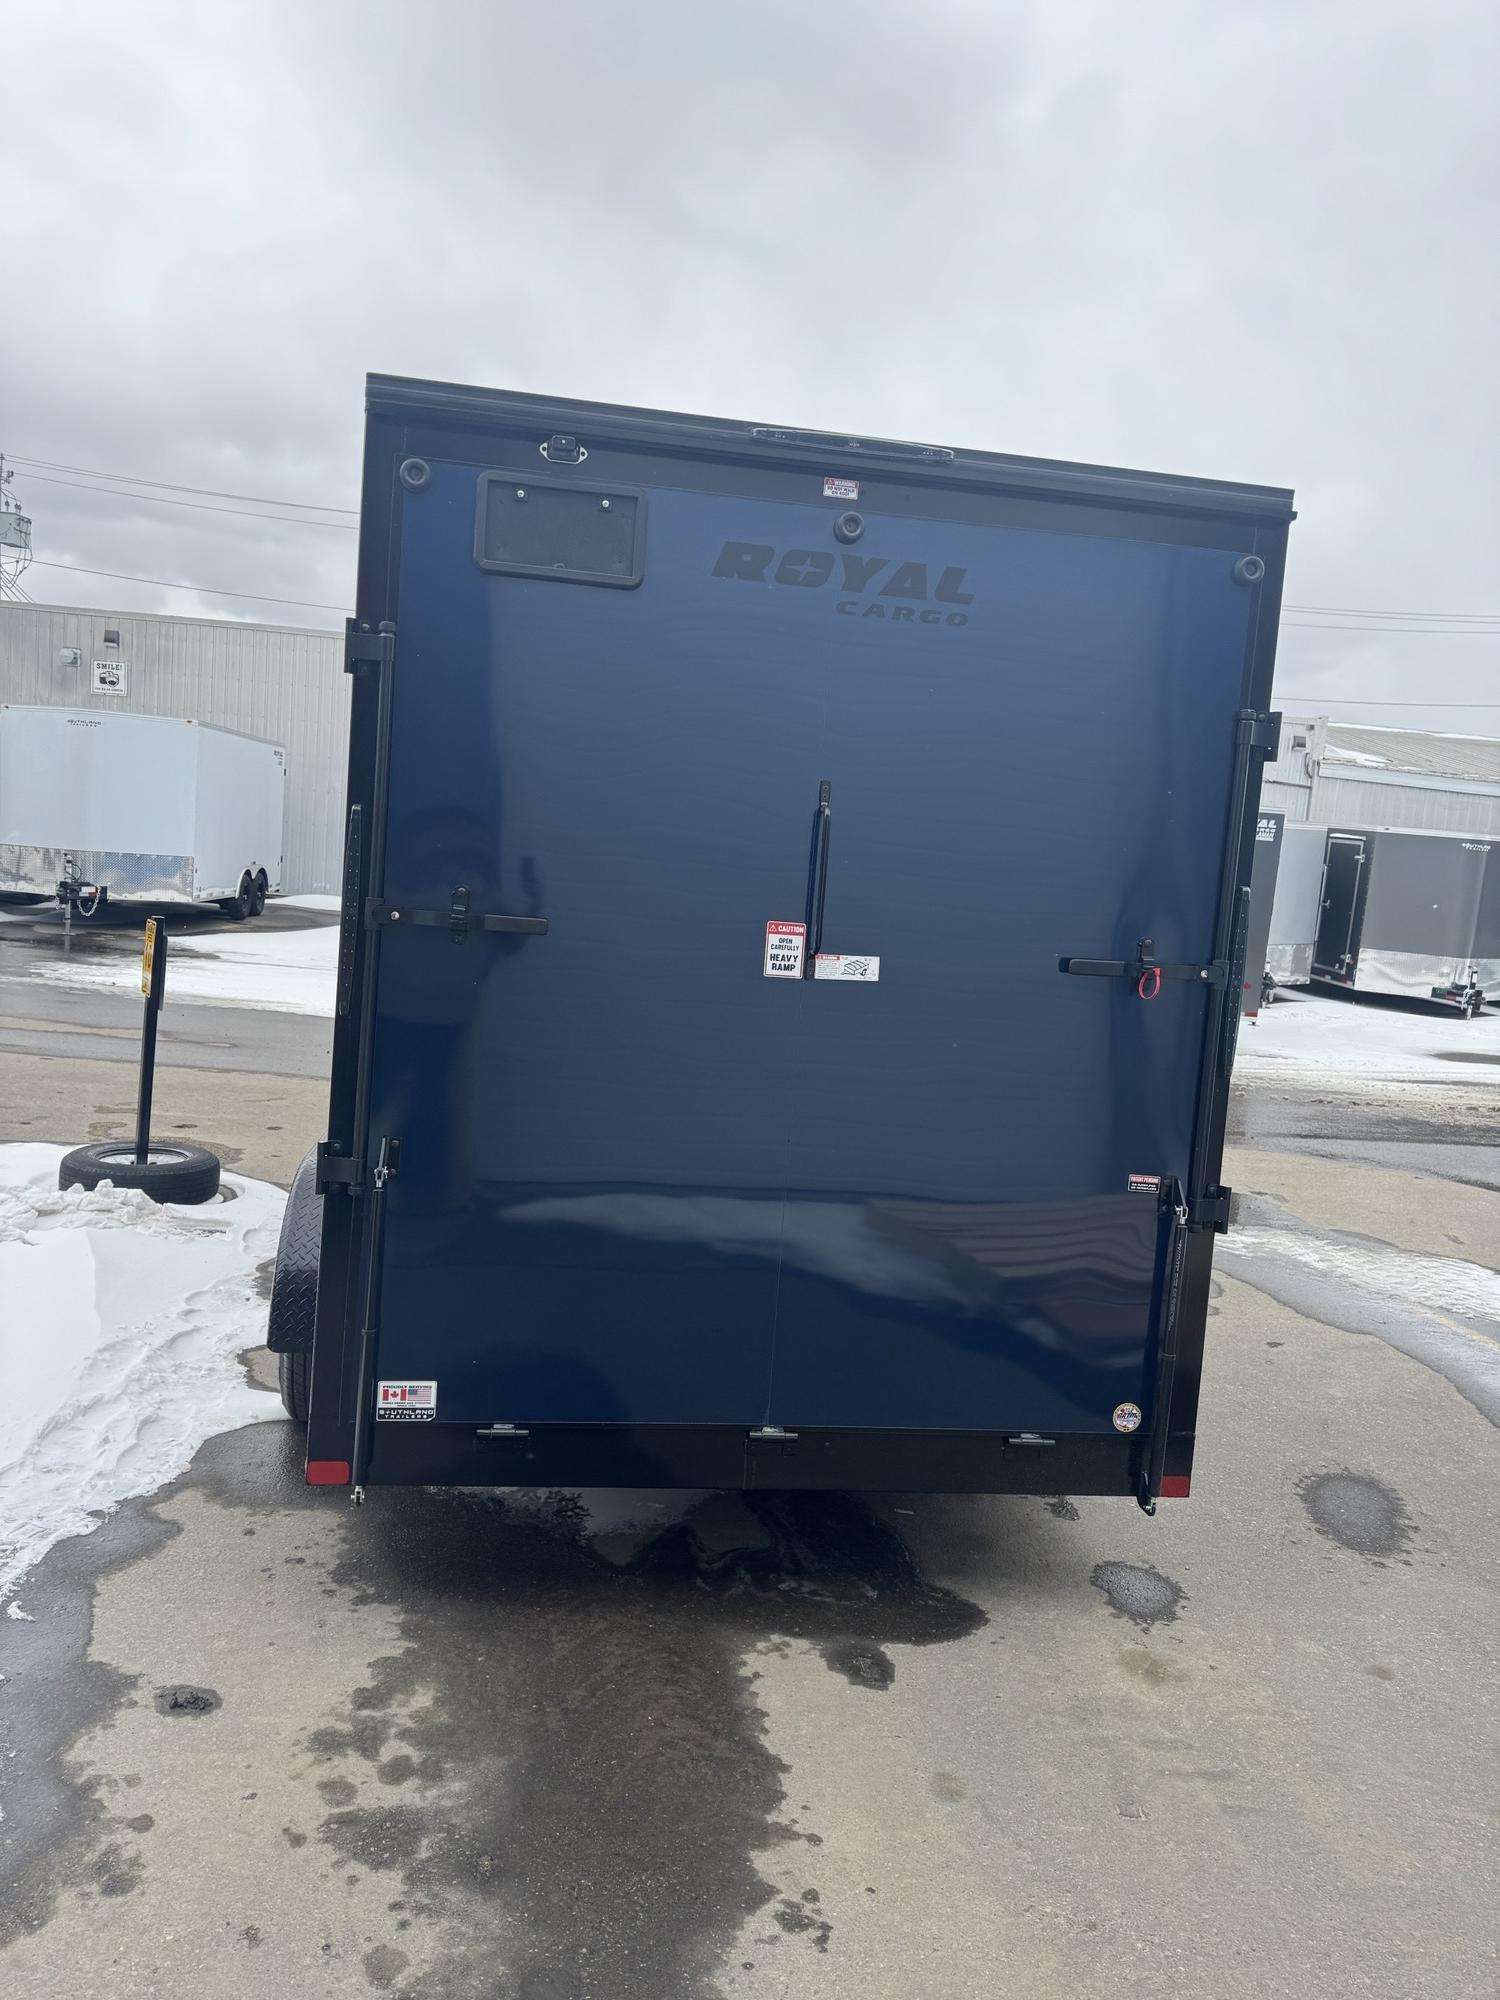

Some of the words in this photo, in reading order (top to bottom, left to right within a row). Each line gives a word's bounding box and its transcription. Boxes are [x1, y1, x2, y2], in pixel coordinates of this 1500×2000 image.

[711, 541, 975, 605] ROYAL
[836, 600, 969, 627] CARGO
[778, 925, 804, 933] CAUTION
[770, 953, 799, 962] HEAVY
[771, 963, 796, 971] RAMP
